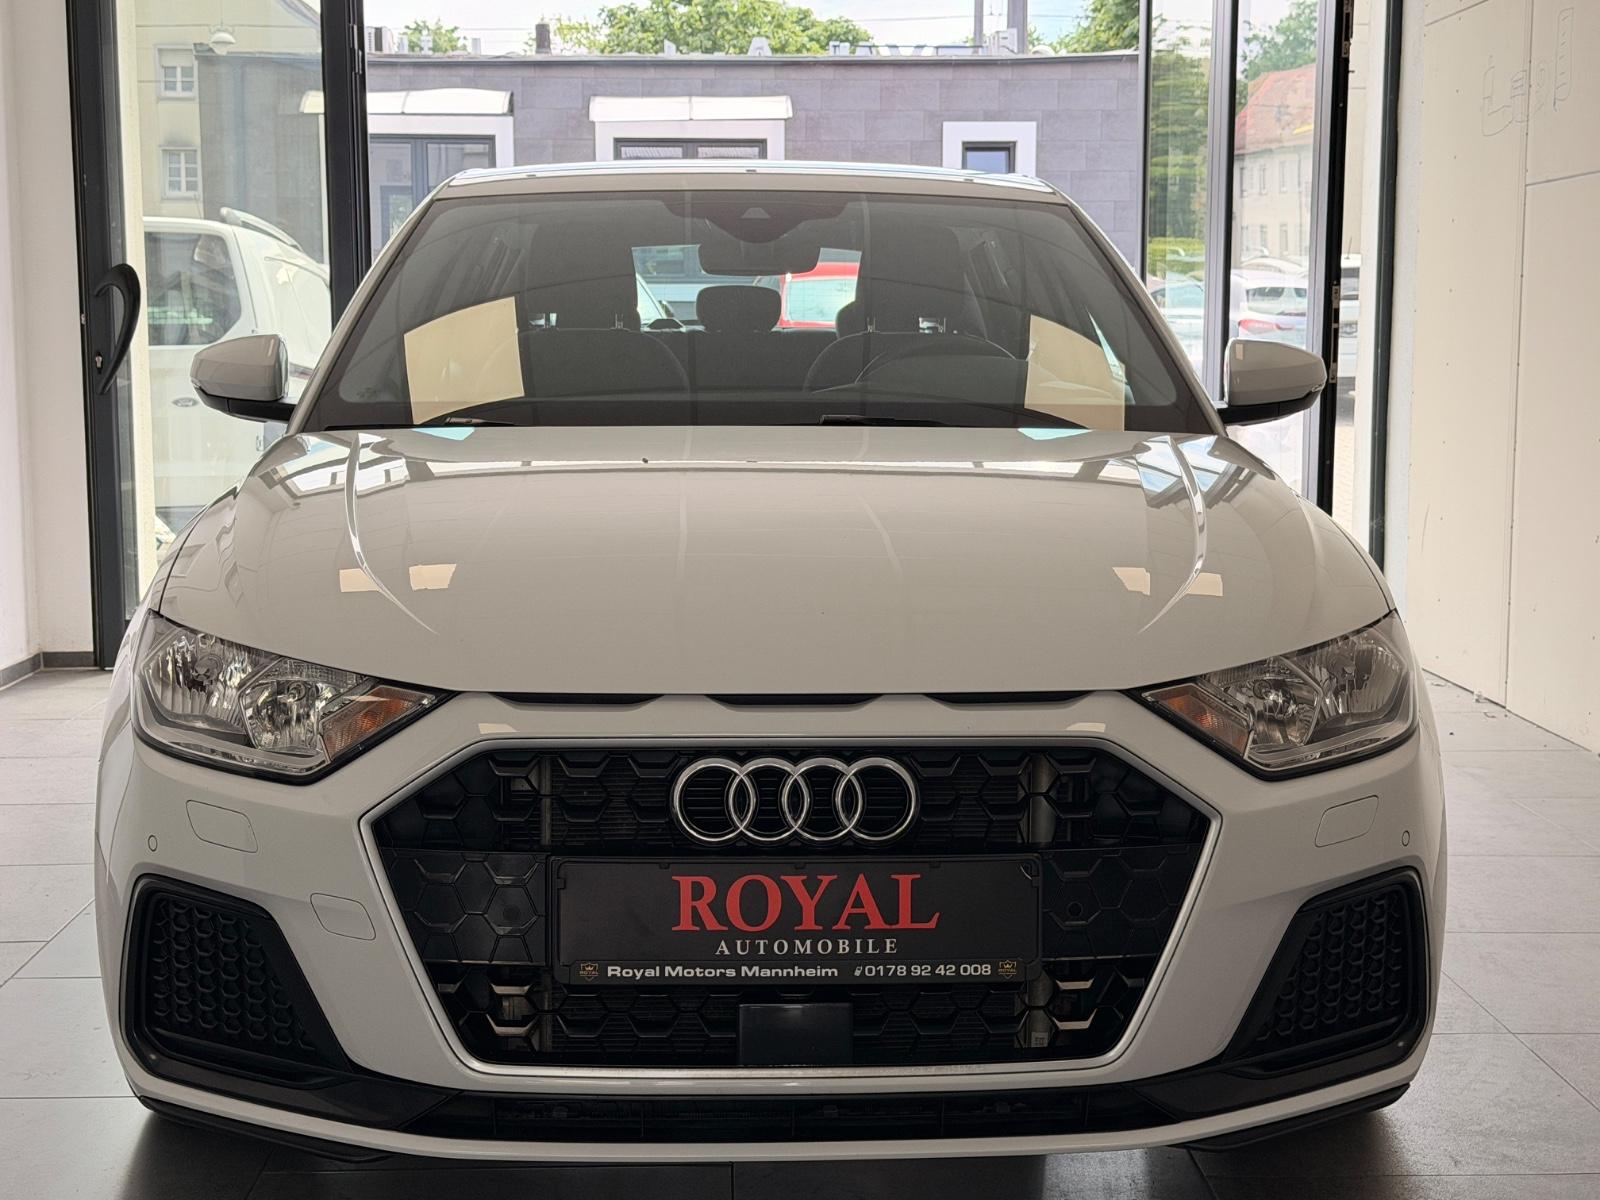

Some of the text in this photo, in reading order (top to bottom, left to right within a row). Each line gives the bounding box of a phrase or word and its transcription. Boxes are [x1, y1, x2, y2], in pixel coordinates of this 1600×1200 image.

[671, 872, 941, 932] ROYAL
[715, 938, 897, 955] AUTOMOBILE
[607, 964, 991, 980] Royal Motors Mannheim 0178 92 42 008
